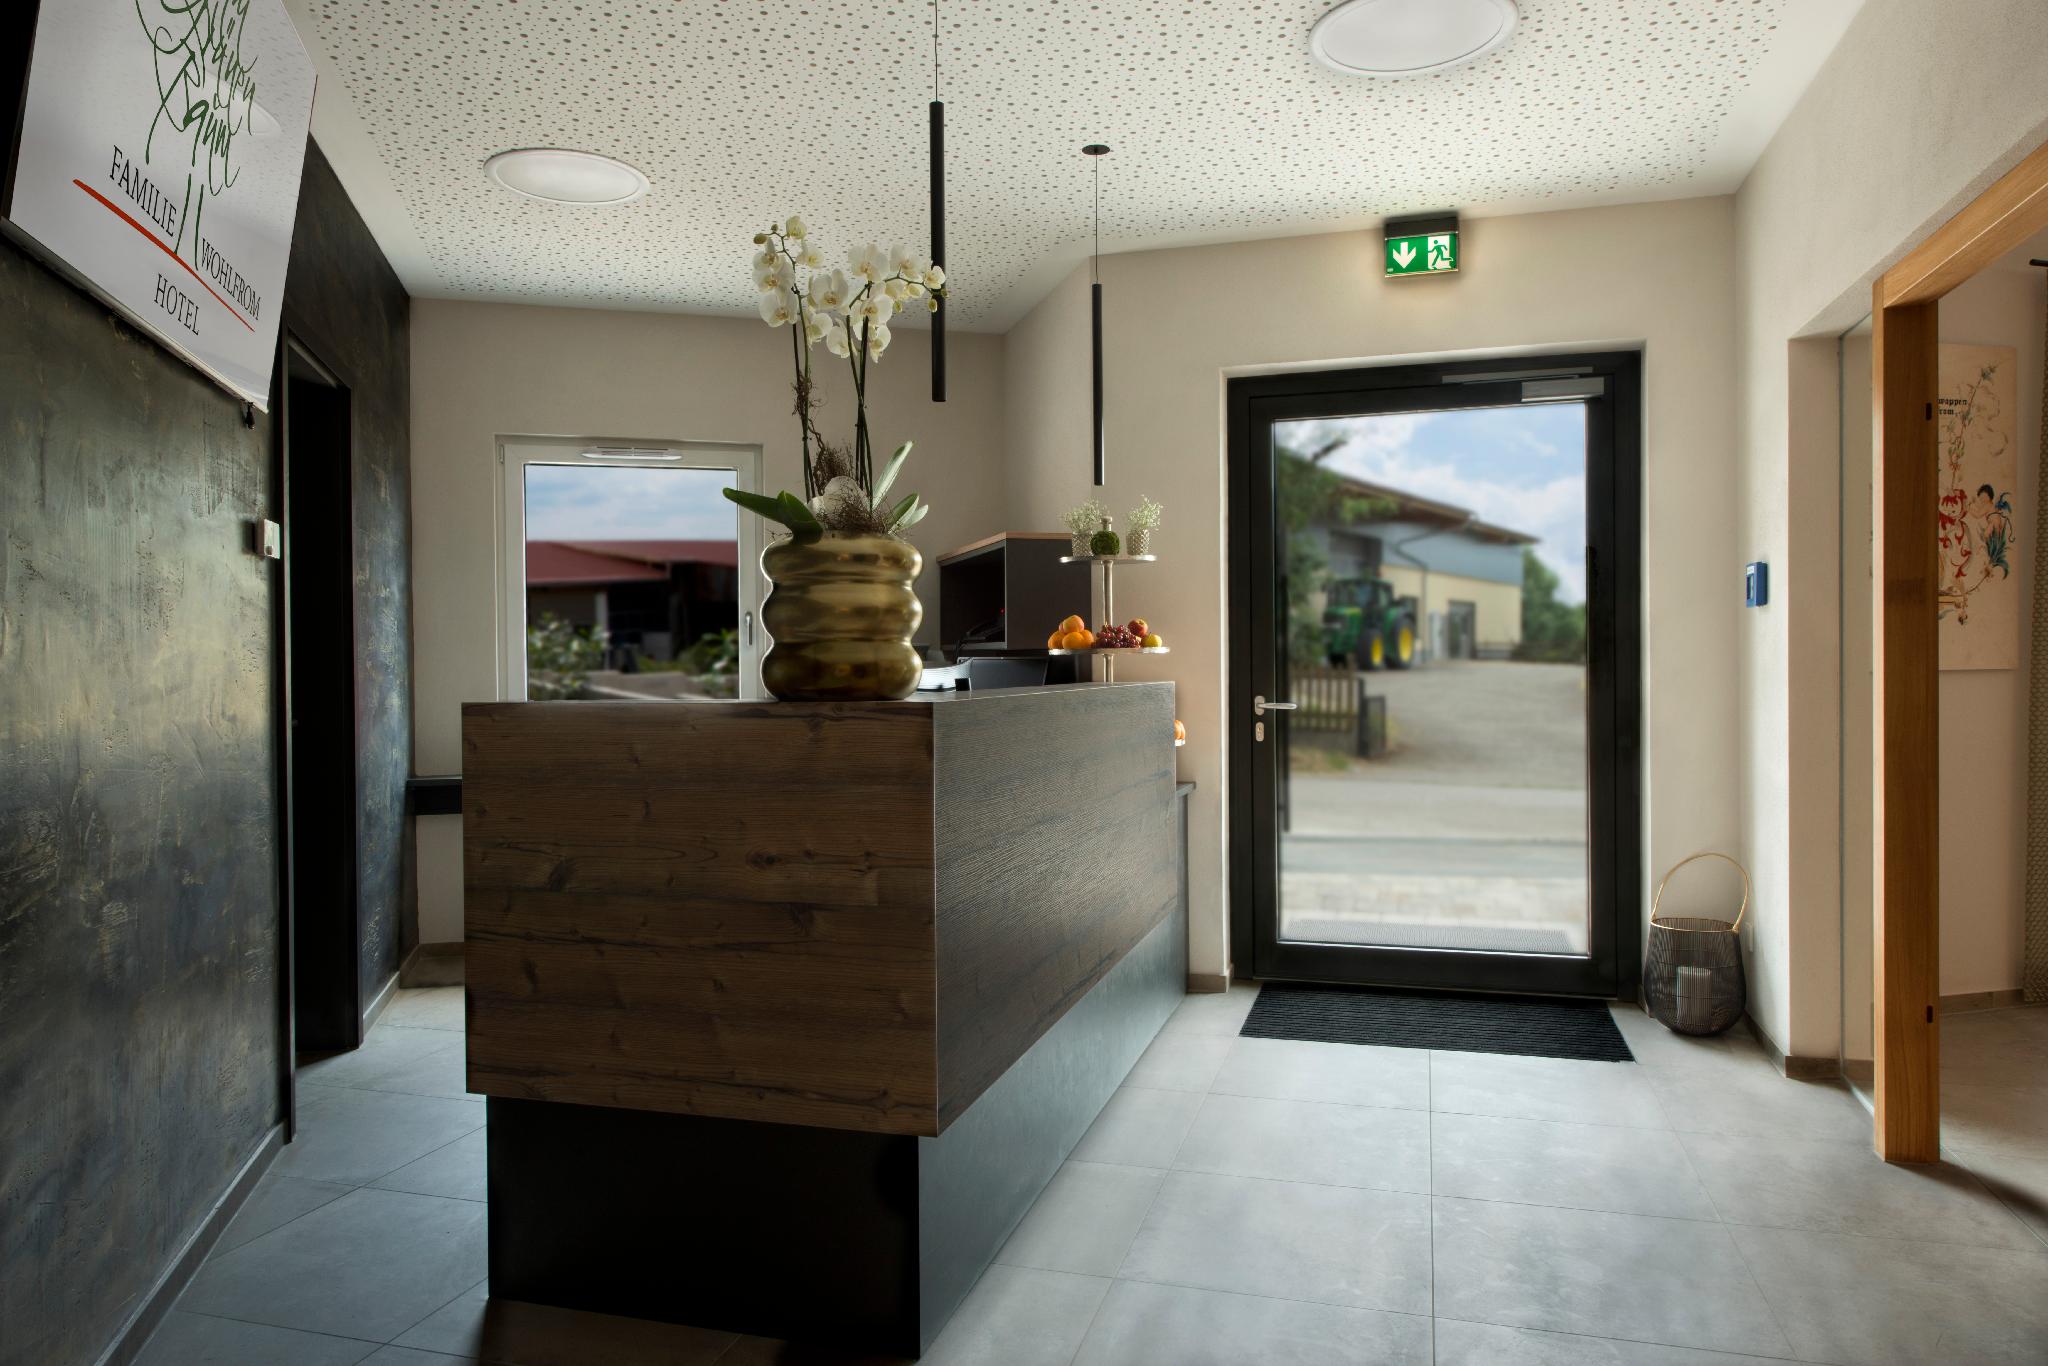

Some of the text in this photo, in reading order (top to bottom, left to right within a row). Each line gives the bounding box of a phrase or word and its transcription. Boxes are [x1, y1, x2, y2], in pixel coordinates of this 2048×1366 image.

[109, 145, 261, 321] FAMILIE WOHLFROM
[154, 273, 200, 336] HOTEL
